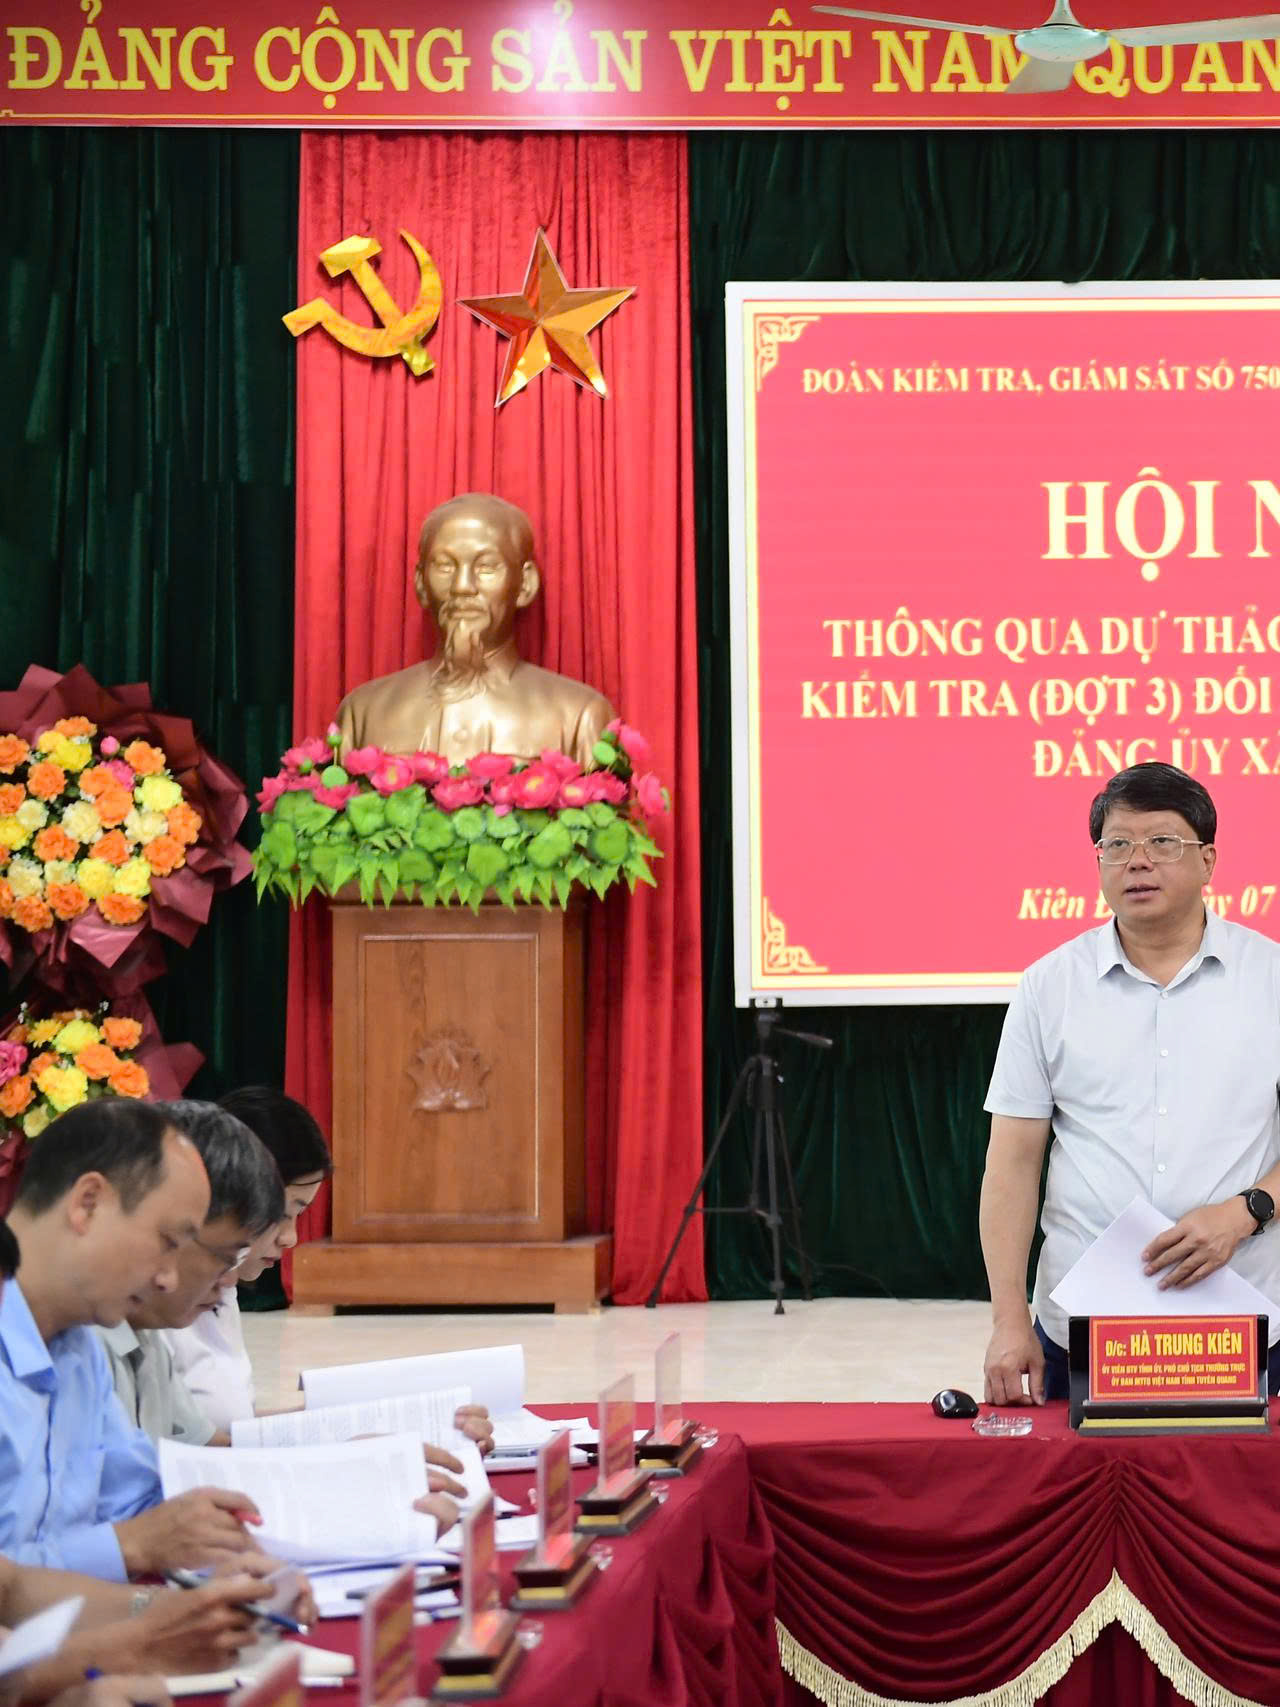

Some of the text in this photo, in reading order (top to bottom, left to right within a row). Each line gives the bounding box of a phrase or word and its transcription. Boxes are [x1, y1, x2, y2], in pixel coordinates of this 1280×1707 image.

[6, 0, 234, 92] ĐẢNG
[254, 6, 472, 110] CỘNG
[490, 0, 648, 93] SẢN
[669, 8, 852, 111] VIỆT
[803, 360, 884, 394] ĐOÀN
[893, 360, 969, 393] KIỂM
[976, 367, 1044, 397] TRA,
[1048, 359, 1128, 392] GIÁM
[1135, 359, 1190, 391] SÁT
[1195, 357, 1235, 391] SỐ
[1041, 466, 1222, 582] HỘI
[823, 606, 984, 658] THÔNG
[994, 617, 1090, 664] QUA
[1100, 609, 1167, 665] DỰ
[801, 669, 918, 719] KIỂM
[928, 679, 1020, 718] TRA
[1028, 674, 1137, 726] (ĐỢT
[1144, 677, 1183, 724] 3)
[1193, 665, 1273, 715] ĐỐI
[1032, 728, 1158, 777] ĐẢNG
[1171, 728, 1230, 776] ỦY
[1017, 888, 1086, 920] Kiên
[1240, 884, 1276, 917] 07
[1130, 1329, 1152, 1357] HÀ
[1154, 1332, 1204, 1356] TRUNG
[1207, 1327, 1243, 1355] KIÊN
